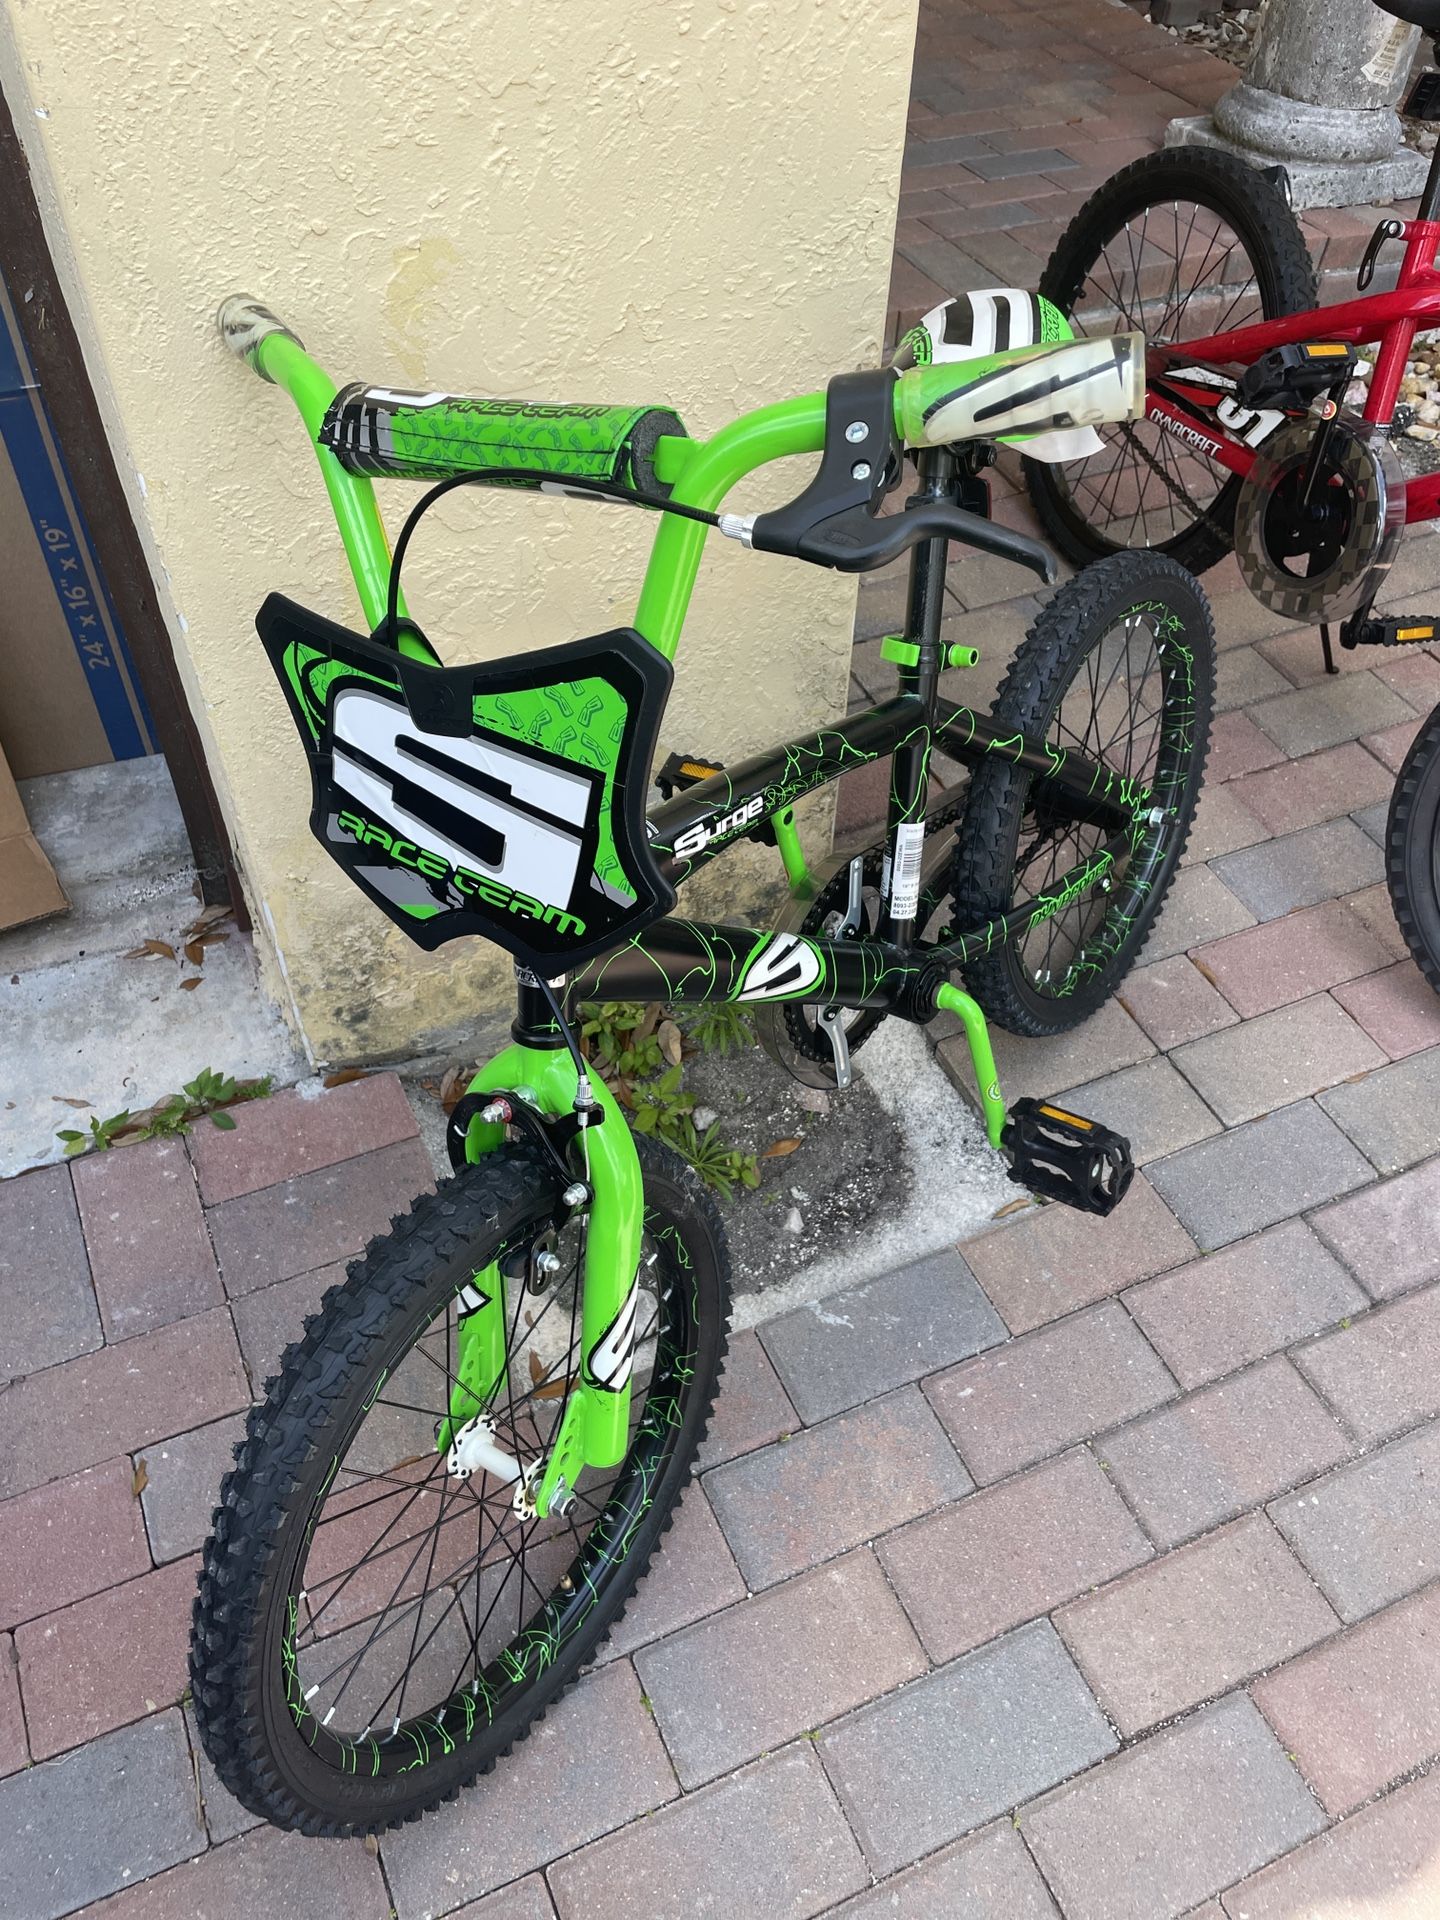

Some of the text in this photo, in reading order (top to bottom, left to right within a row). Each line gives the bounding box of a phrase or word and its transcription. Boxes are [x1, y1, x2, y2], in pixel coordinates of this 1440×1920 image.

[1150, 408, 1223, 457] DYNACRAFT
[39, 519, 71, 552] 19"
[60, 579, 90, 610] 16"
[79, 634, 111, 669] 24"
[337, 810, 451, 880] RACE
[673, 796, 764, 860] Surge
